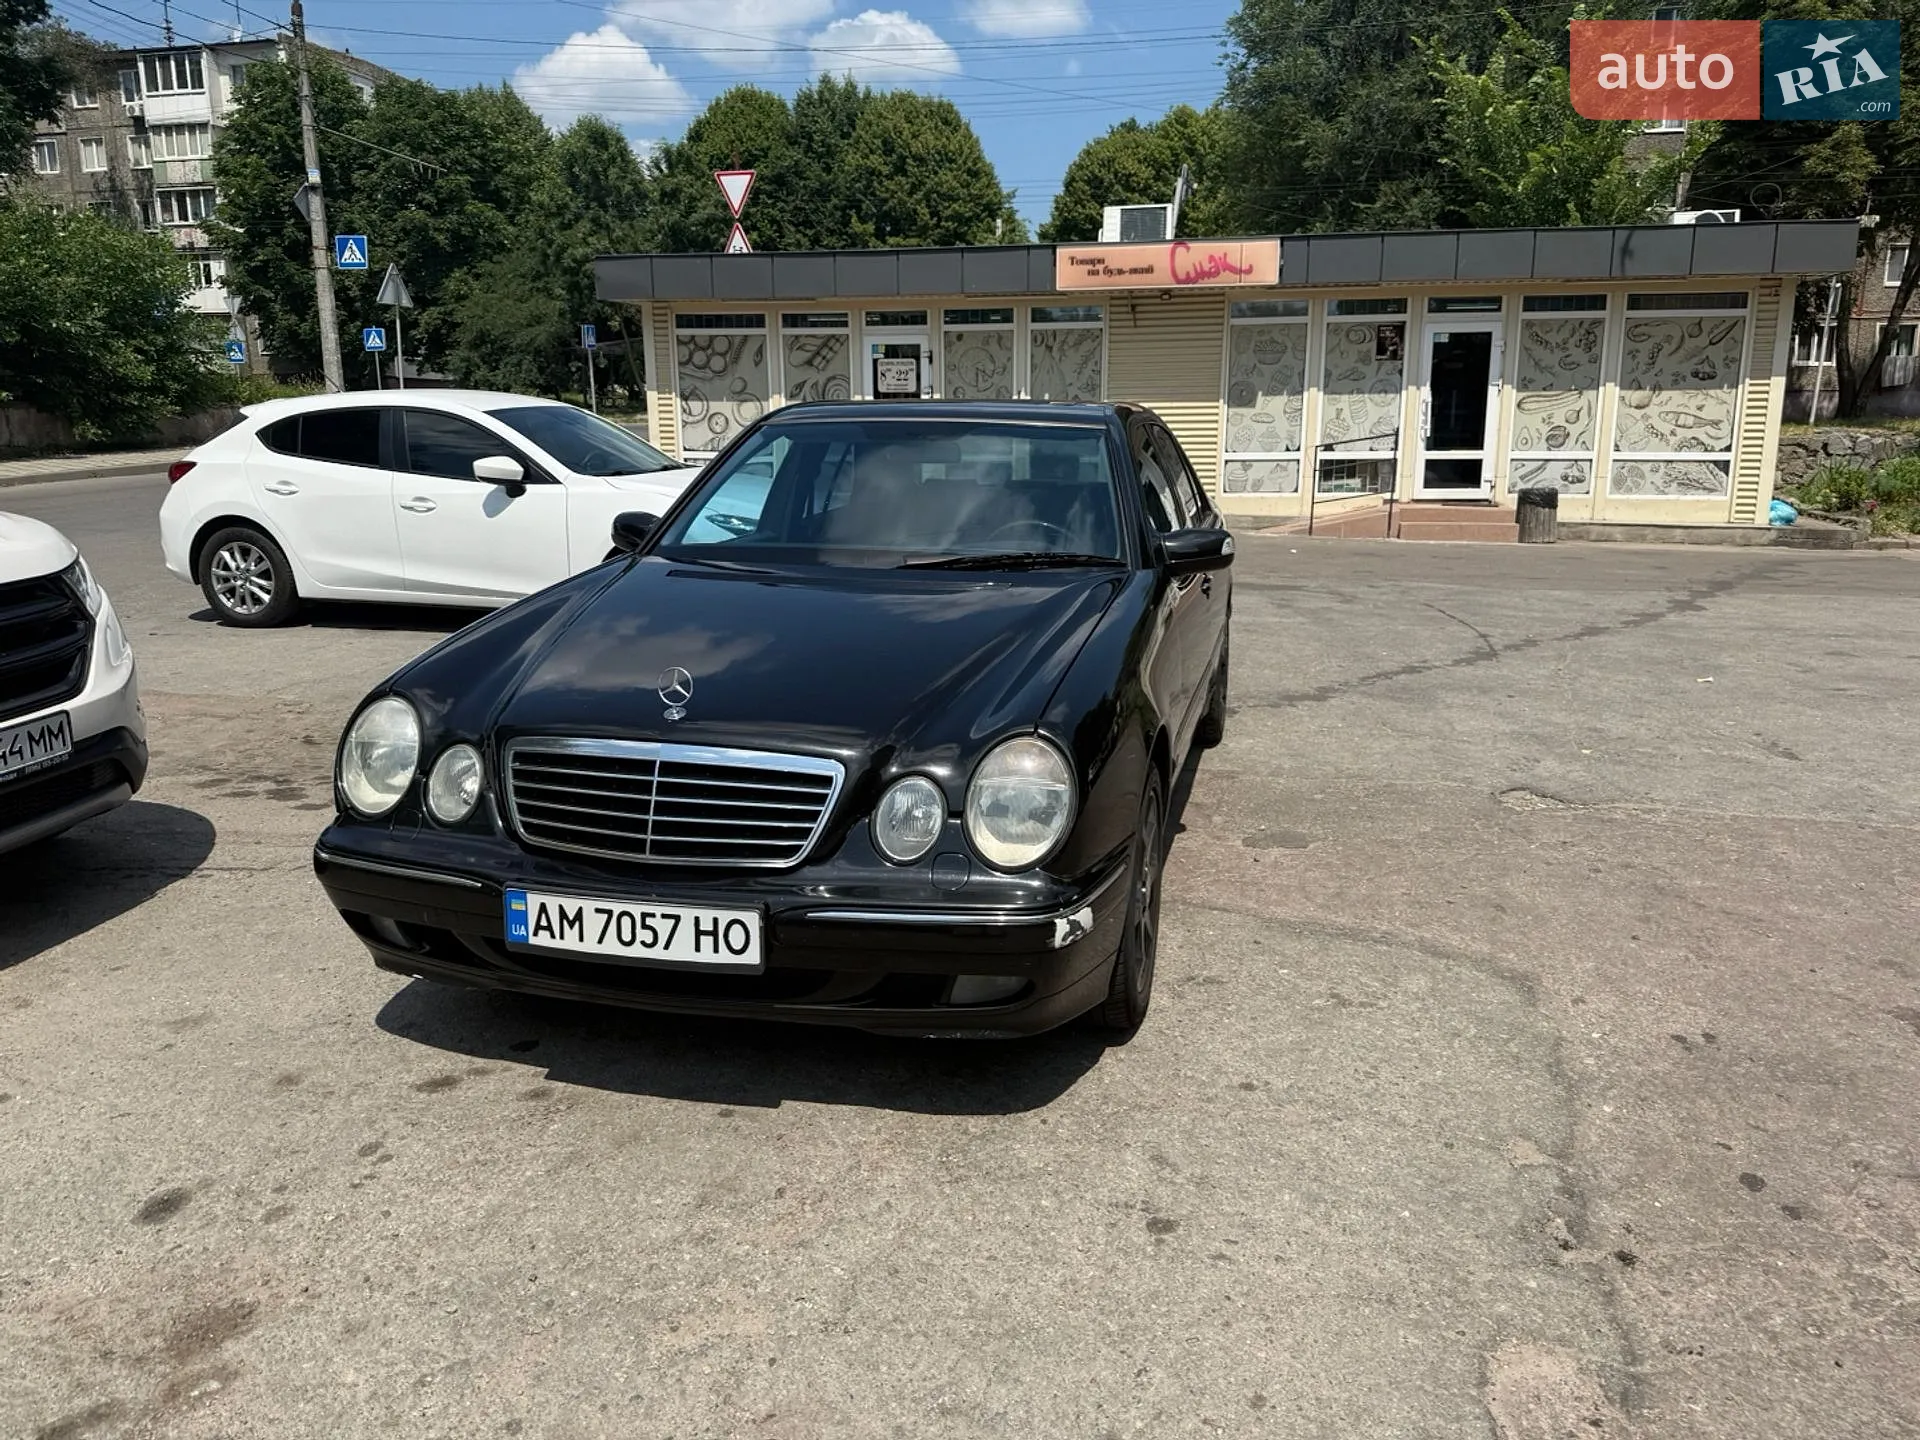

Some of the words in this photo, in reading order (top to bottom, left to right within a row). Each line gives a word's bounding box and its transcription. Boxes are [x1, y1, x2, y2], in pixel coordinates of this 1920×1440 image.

[27, 720, 66, 757] MM
[511, 924, 527, 936] UA
[532, 902, 584, 943] AM
[594, 907, 681, 950] 7057
[693, 916, 751, 955] HO
